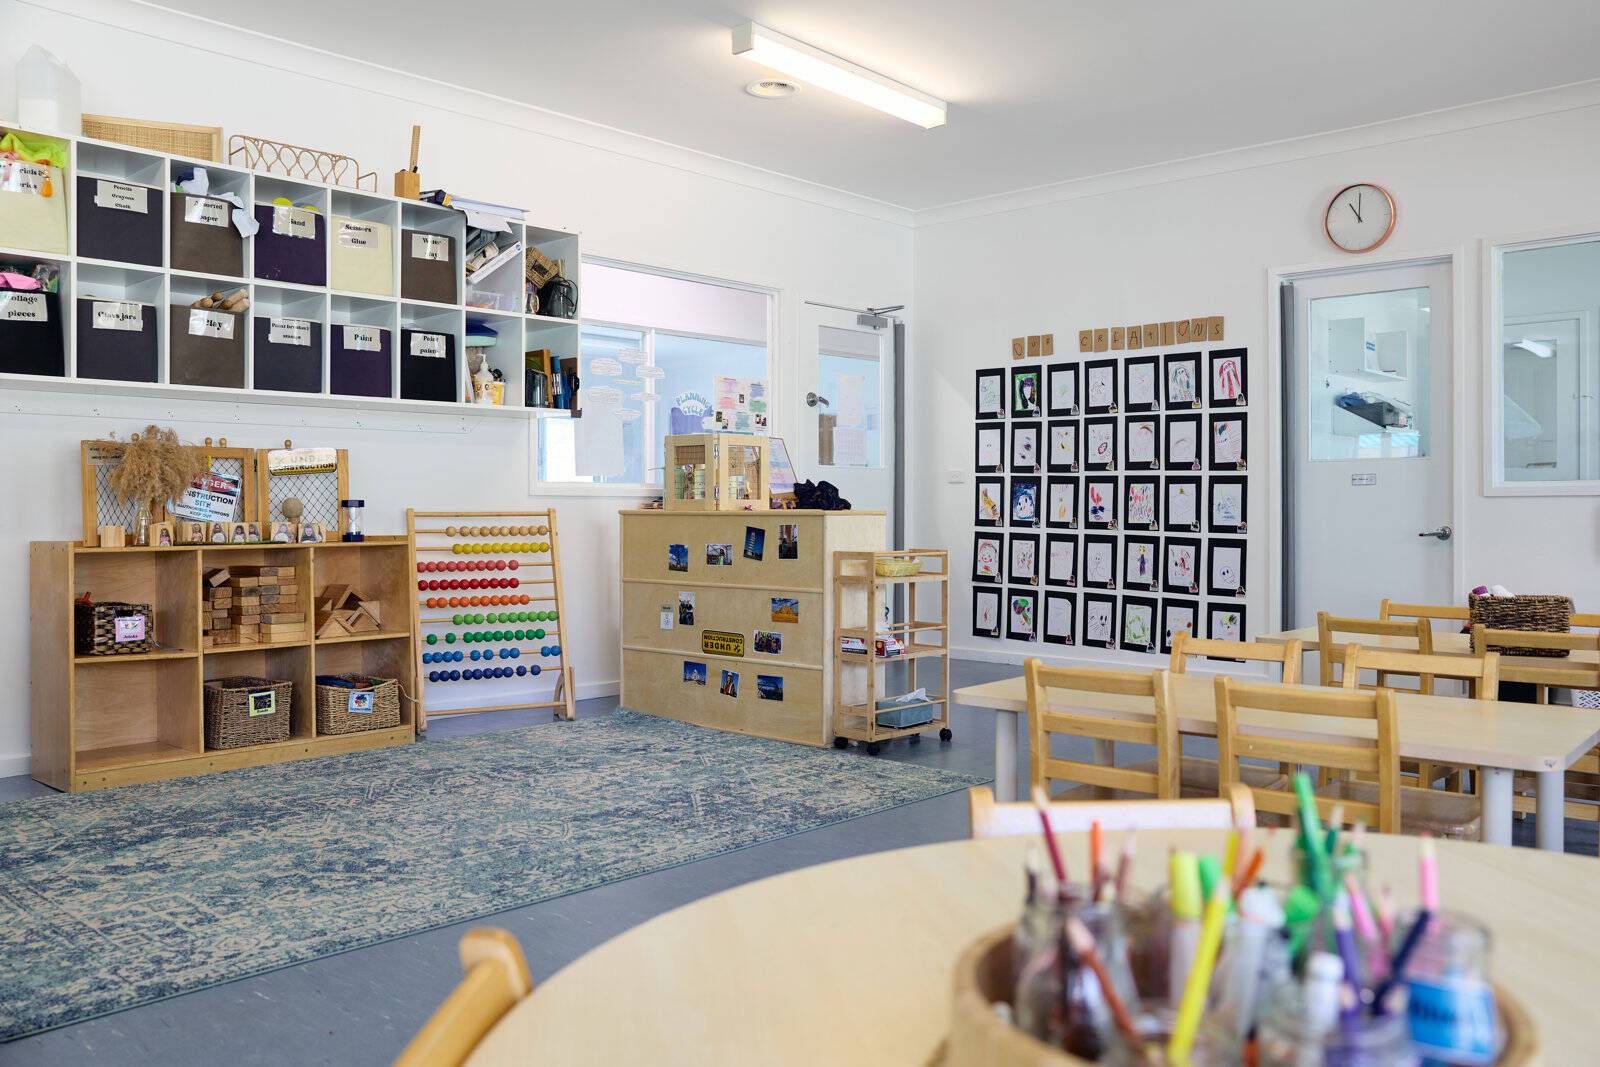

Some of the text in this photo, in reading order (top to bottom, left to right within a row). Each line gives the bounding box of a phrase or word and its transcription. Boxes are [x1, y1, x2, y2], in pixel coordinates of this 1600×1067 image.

[191, 200, 223, 210] Asorted
[351, 237, 367, 245] Glue
[11, 295, 38, 305] ollage
[7, 310, 36, 318] pieces
[184, 489, 235, 505] NSTRUCTION
[704, 634, 743, 644] CONSTRUCTION
[704, 641, 731, 651] UNDER
